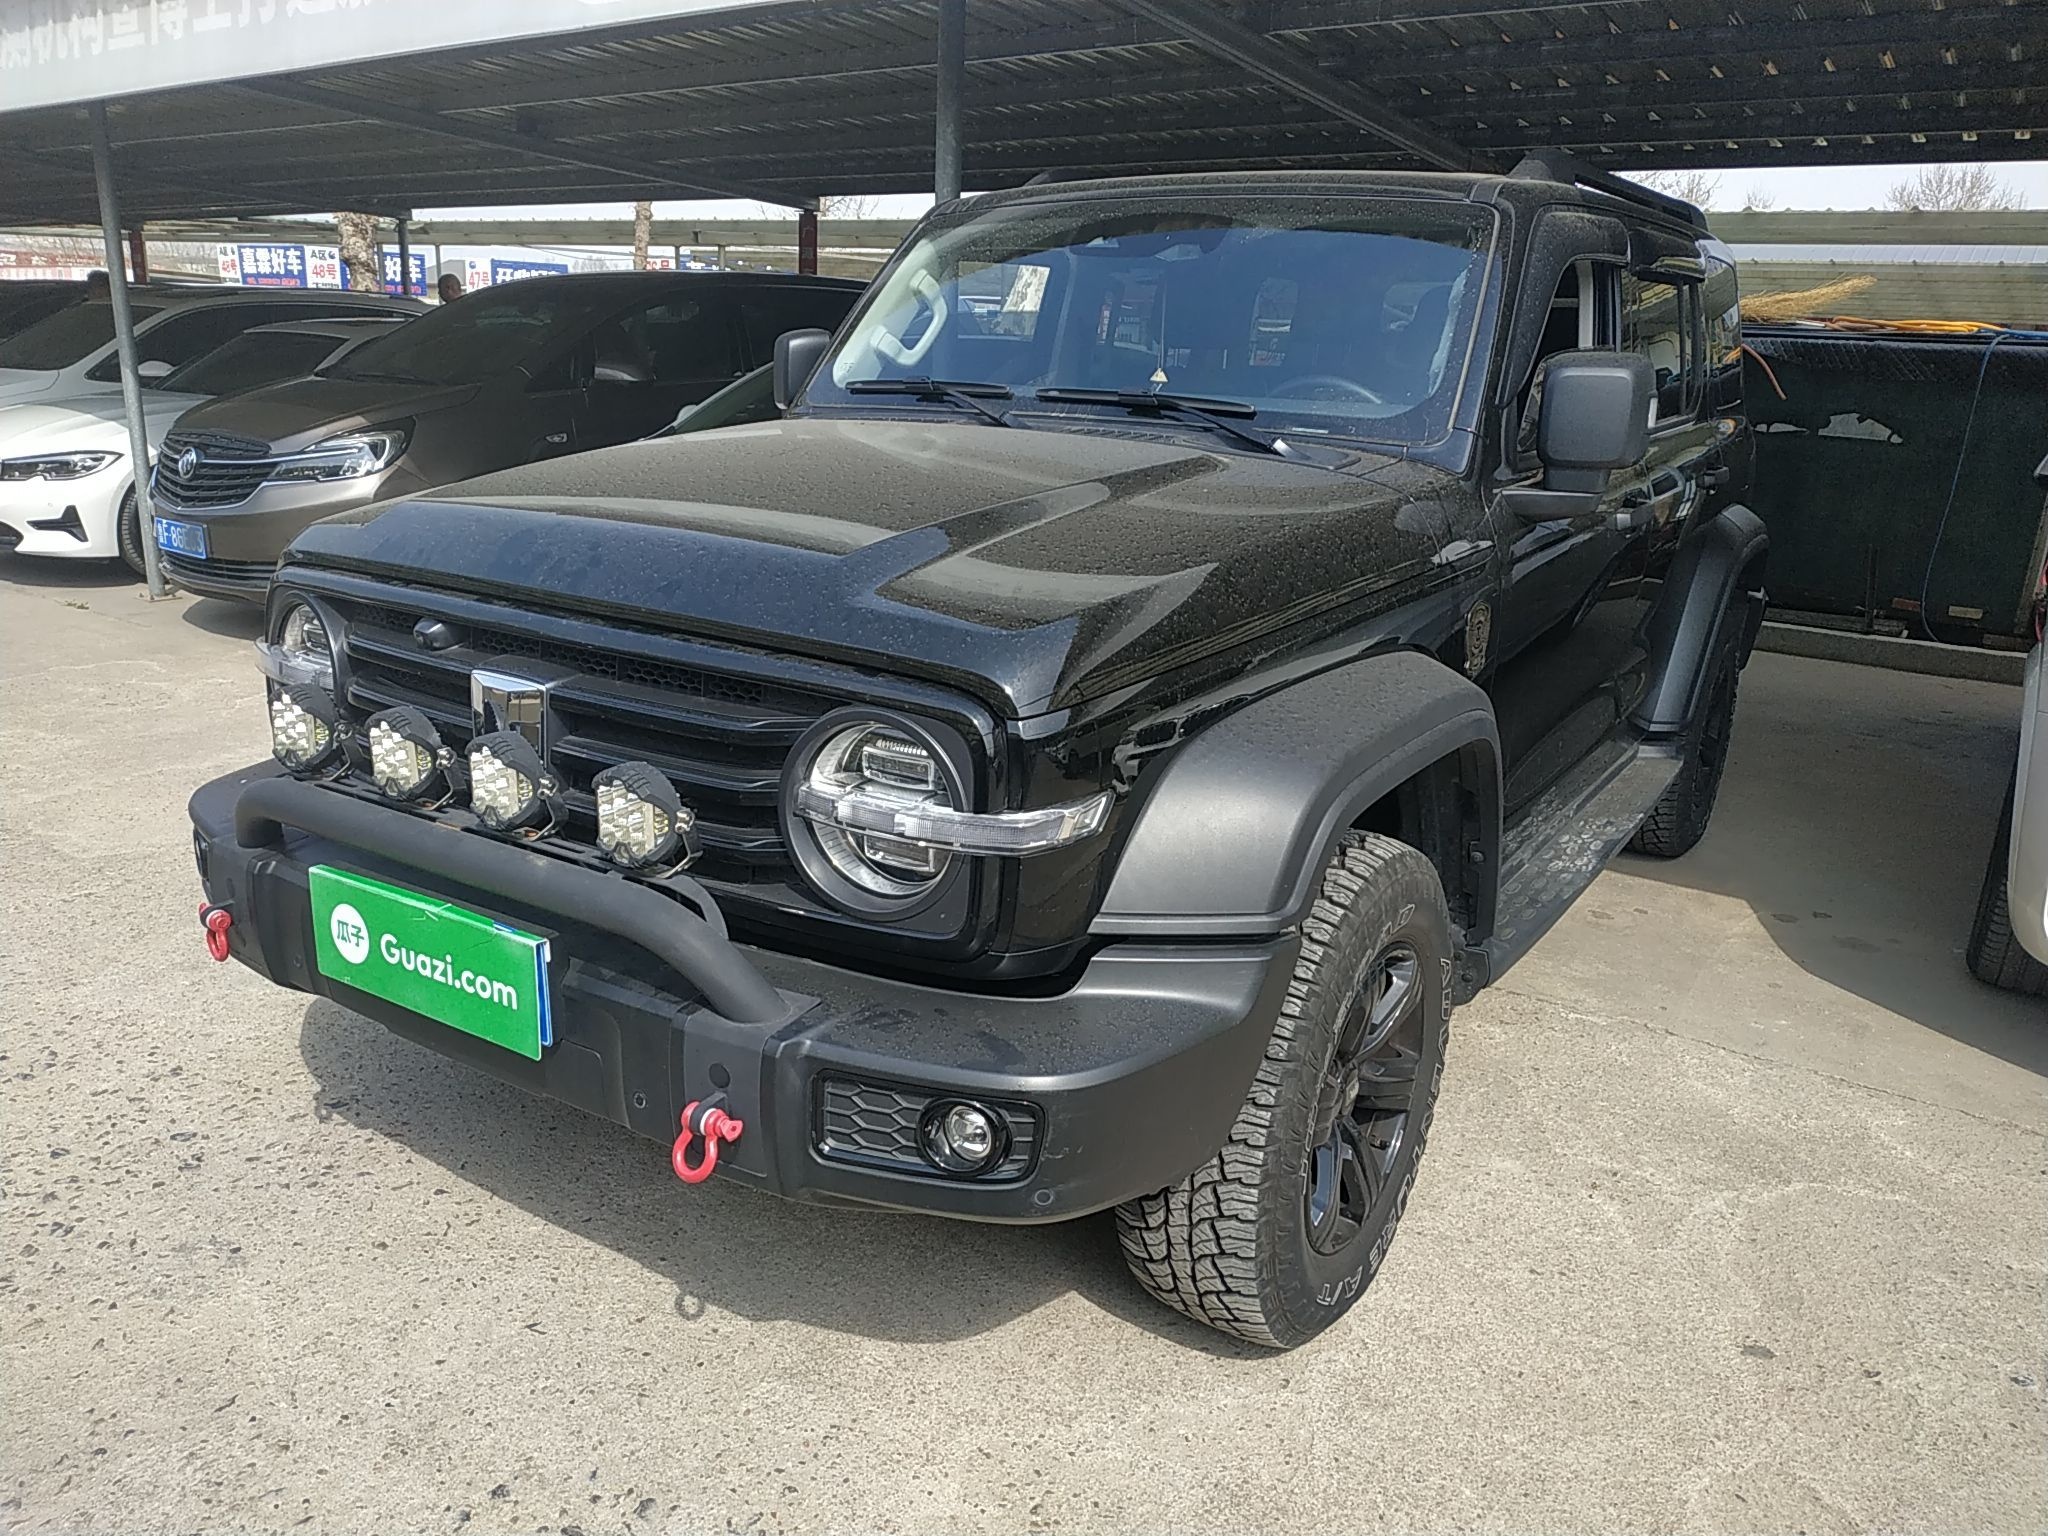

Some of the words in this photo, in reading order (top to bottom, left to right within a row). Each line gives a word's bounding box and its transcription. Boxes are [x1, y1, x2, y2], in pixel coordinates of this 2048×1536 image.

[312, 263, 337, 280] 48号
[468, 271, 490, 289] 47号
[337, 919, 365, 948] 瓜子
[380, 933, 519, 1011] Guazi.com
[1316, 1265, 1364, 1306] A/T
